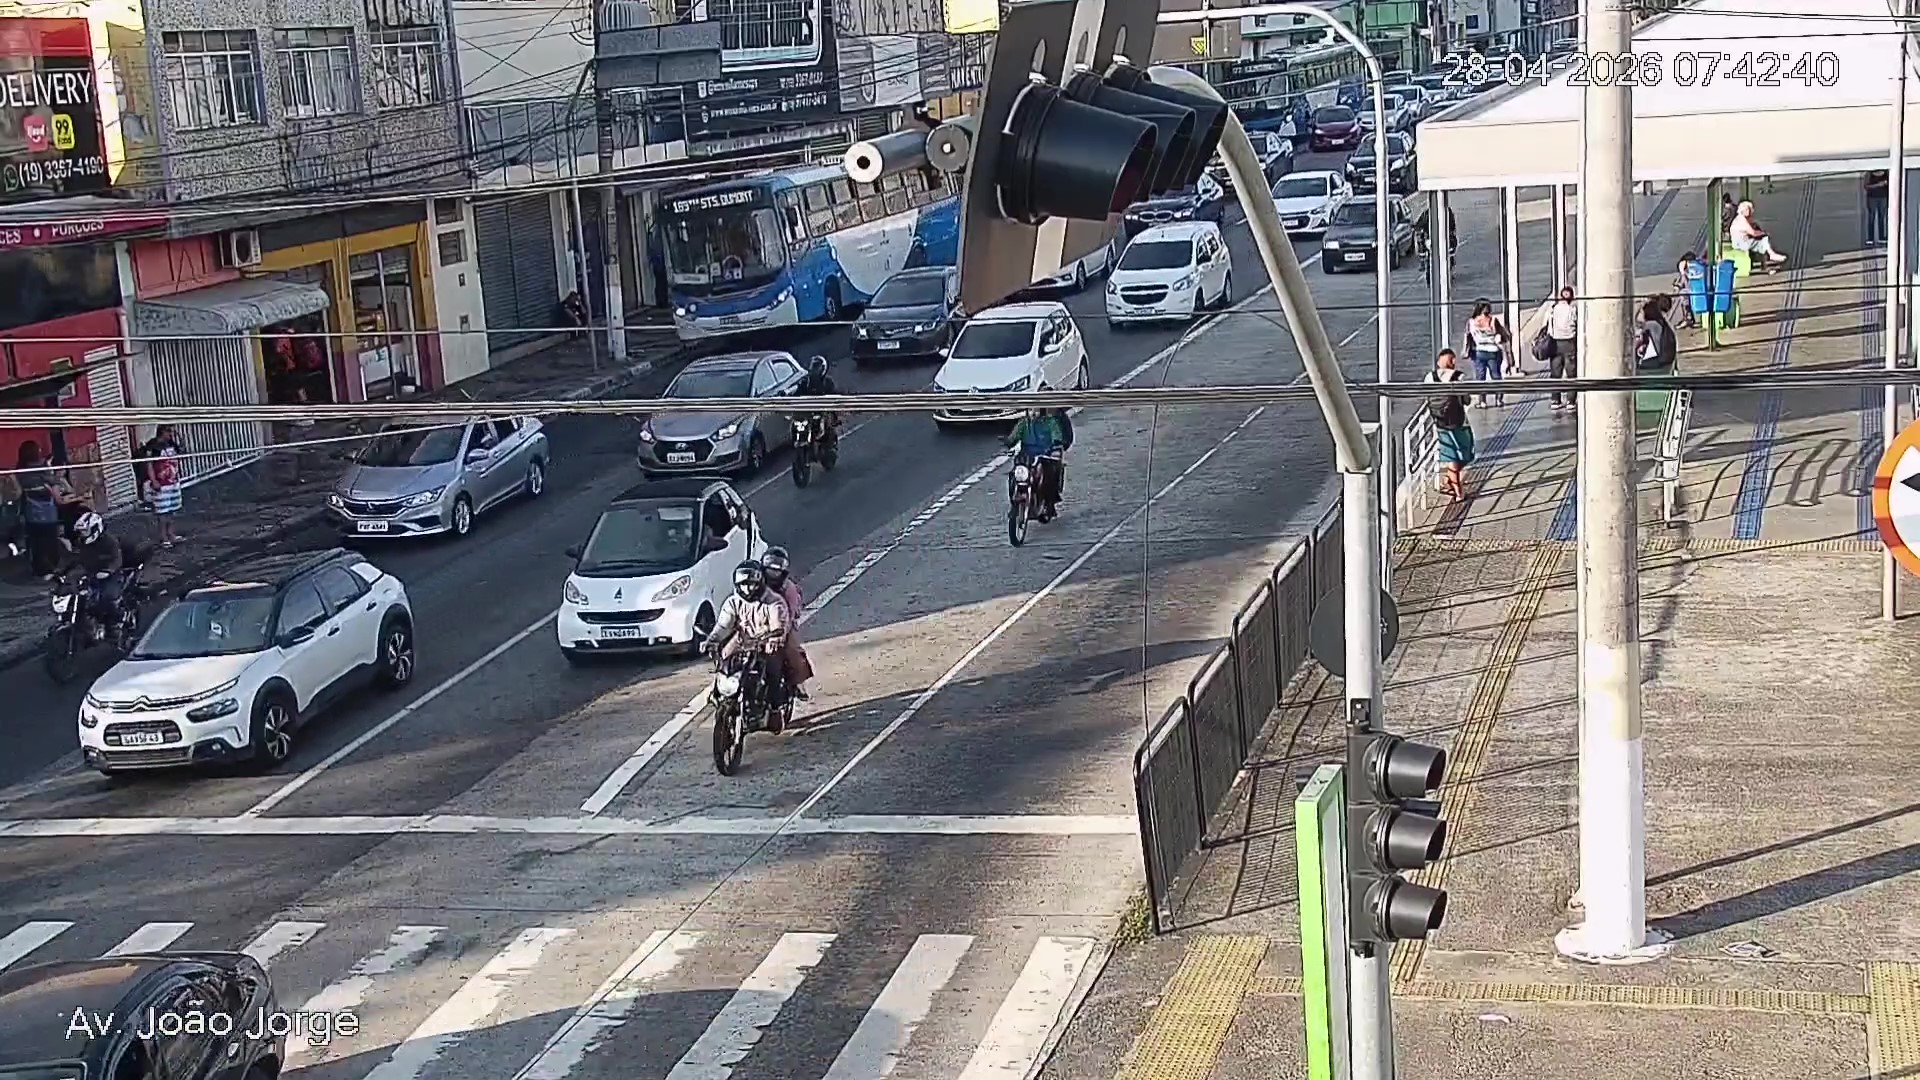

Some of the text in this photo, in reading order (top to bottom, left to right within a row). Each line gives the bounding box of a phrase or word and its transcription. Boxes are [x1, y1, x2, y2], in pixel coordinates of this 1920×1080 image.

[0, 72, 90, 108] DELIVERY
[55, 119, 69, 136] 99
[19, 162, 43, 188] (19)
